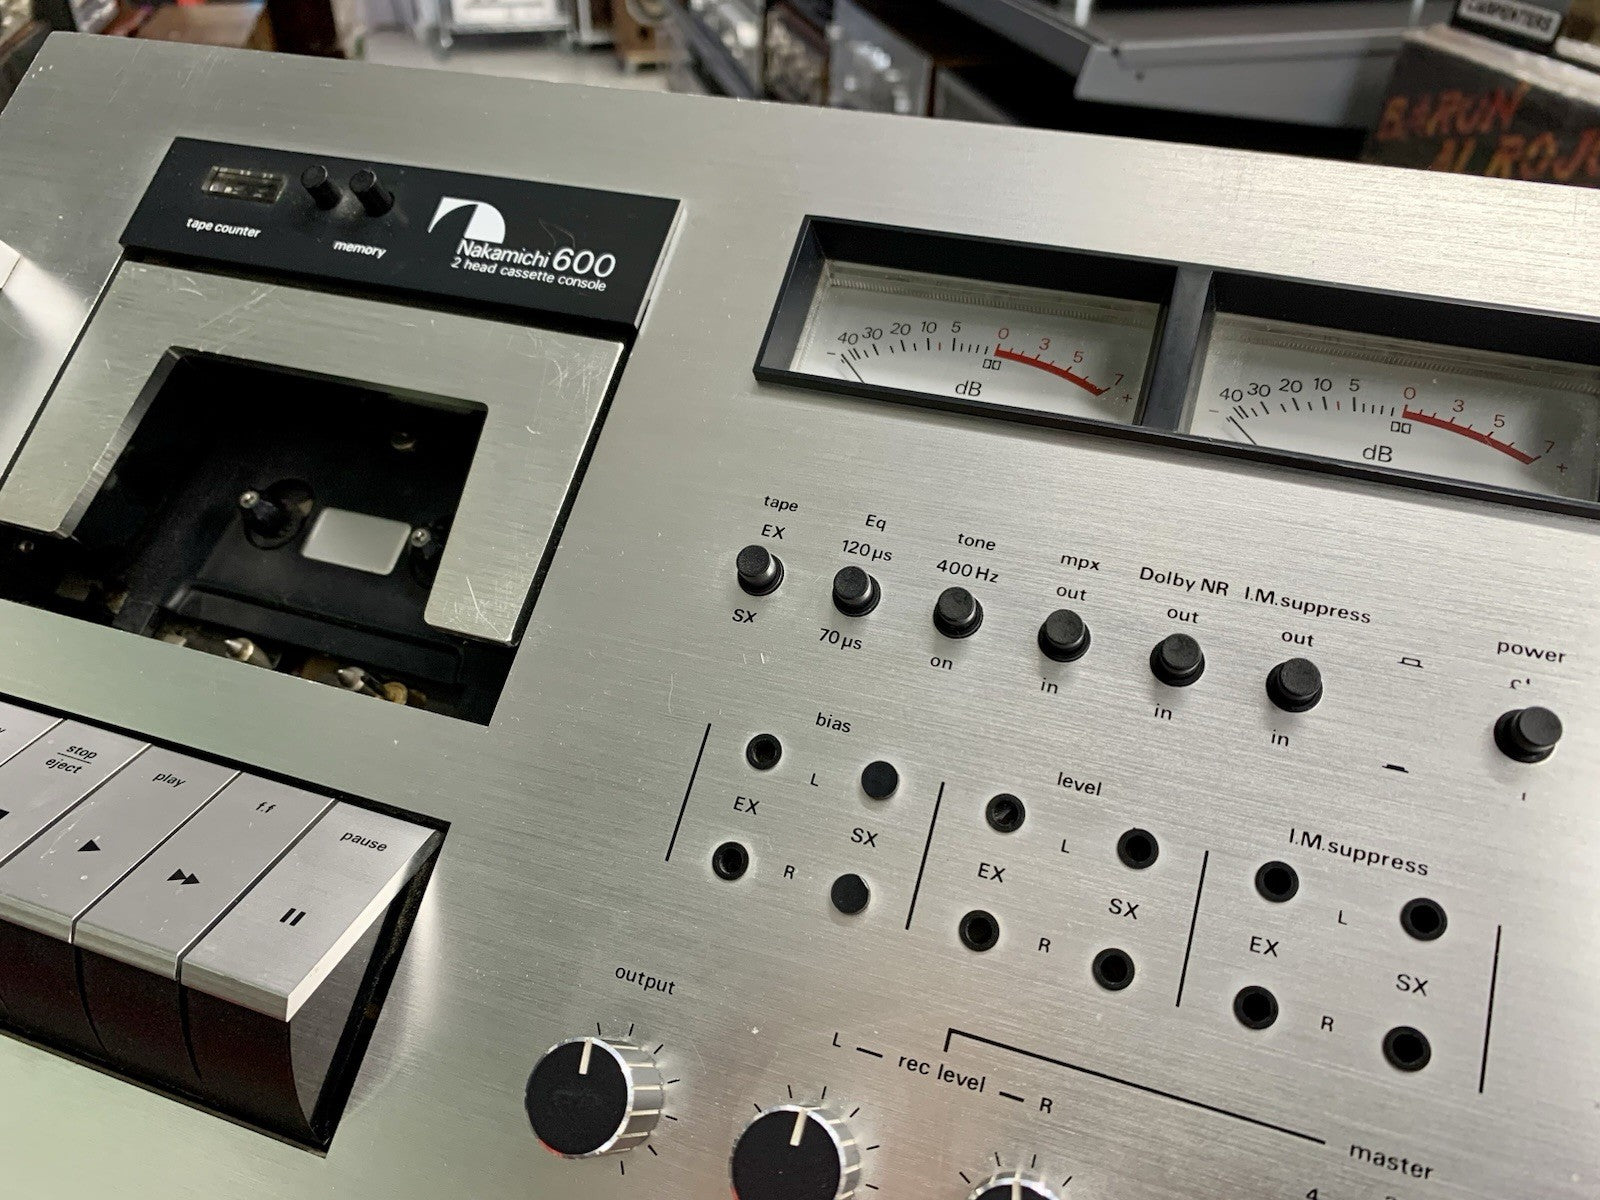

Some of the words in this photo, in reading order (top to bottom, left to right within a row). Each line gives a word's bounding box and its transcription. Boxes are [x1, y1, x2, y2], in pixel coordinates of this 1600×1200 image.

[186, 218, 214, 232] tape
[214, 223, 262, 238] counter
[333, 241, 387, 259] memory
[456, 239, 551, 268] Nakamichi
[552, 247, 616, 278] 600
[450, 257, 461, 269] 2
[463, 258, 497, 275] head
[500, 266, 555, 284] cassette
[557, 275, 607, 292] console
[837, 331, 859, 346] 40
[861, 326, 884, 341] 30
[889, 322, 912, 336] 20
[921, 320, 938, 334] 10
[951, 319, 962, 334] 5
[997, 327, 1010, 340] 0
[1038, 337, 1051, 351] 3
[1073, 350, 1084, 364] 5
[1114, 373, 1125, 386] 7
[955, 380, 982, 397] dB
[1219, 387, 1244, 403] 40
[1246, 382, 1271, 398] 30
[1278, 378, 1303, 394] 20
[1314, 377, 1333, 392] 10
[1348, 377, 1360, 392] 5
[1403, 386, 1417, 400] 0
[1452, 398, 1465, 413] 3
[1493, 413, 1506, 428] 5
[1544, 439, 1556, 454] 7
[1362, 444, 1393, 463] dB
[764, 495, 799, 512] tape
[760, 524, 786, 540] EX
[865, 514, 887, 532] Eq
[958, 533, 996, 551] tone
[1060, 554, 1100, 571] mpx
[1139, 566, 1196, 593] Dolby
[1200, 578, 1229, 597] NR
[1056, 586, 1087, 602] out
[731, 608, 758, 624] SX
[1167, 608, 1199, 624] out
[1281, 631, 1315, 648] out
[1497, 641, 1565, 663] power
[930, 656, 953, 671] on
[1040, 677, 1059, 695] in
[1154, 702, 1172, 721] in
[815, 711, 852, 733] bias
[1271, 728, 1289, 747] in
[66, 745, 98, 760] stop
[45, 759, 83, 774] eject
[152, 771, 186, 788] play
[810, 772, 819, 787] L
[1057, 771, 1102, 796] level
[733, 795, 760, 816] EX
[339, 828, 388, 852] pause
[850, 827, 879, 848] SX
[1060, 838, 1070, 854] L
[783, 864, 796, 880] R
[977, 862, 1006, 884] EX
[1108, 898, 1140, 920] SX
[1337, 909, 1348, 926] L
[1037, 937, 1051, 953] R
[1249, 935, 1280, 958] EX
[614, 964, 676, 995] output
[1395, 973, 1429, 997] SX
[1320, 1015, 1334, 1032] R
[832, 1031, 842, 1048] L
[898, 1055, 931, 1076] rec
[937, 1063, 986, 1093] level
[1039, 1097, 1053, 1114] R
[1349, 1144, 1434, 1180] master
